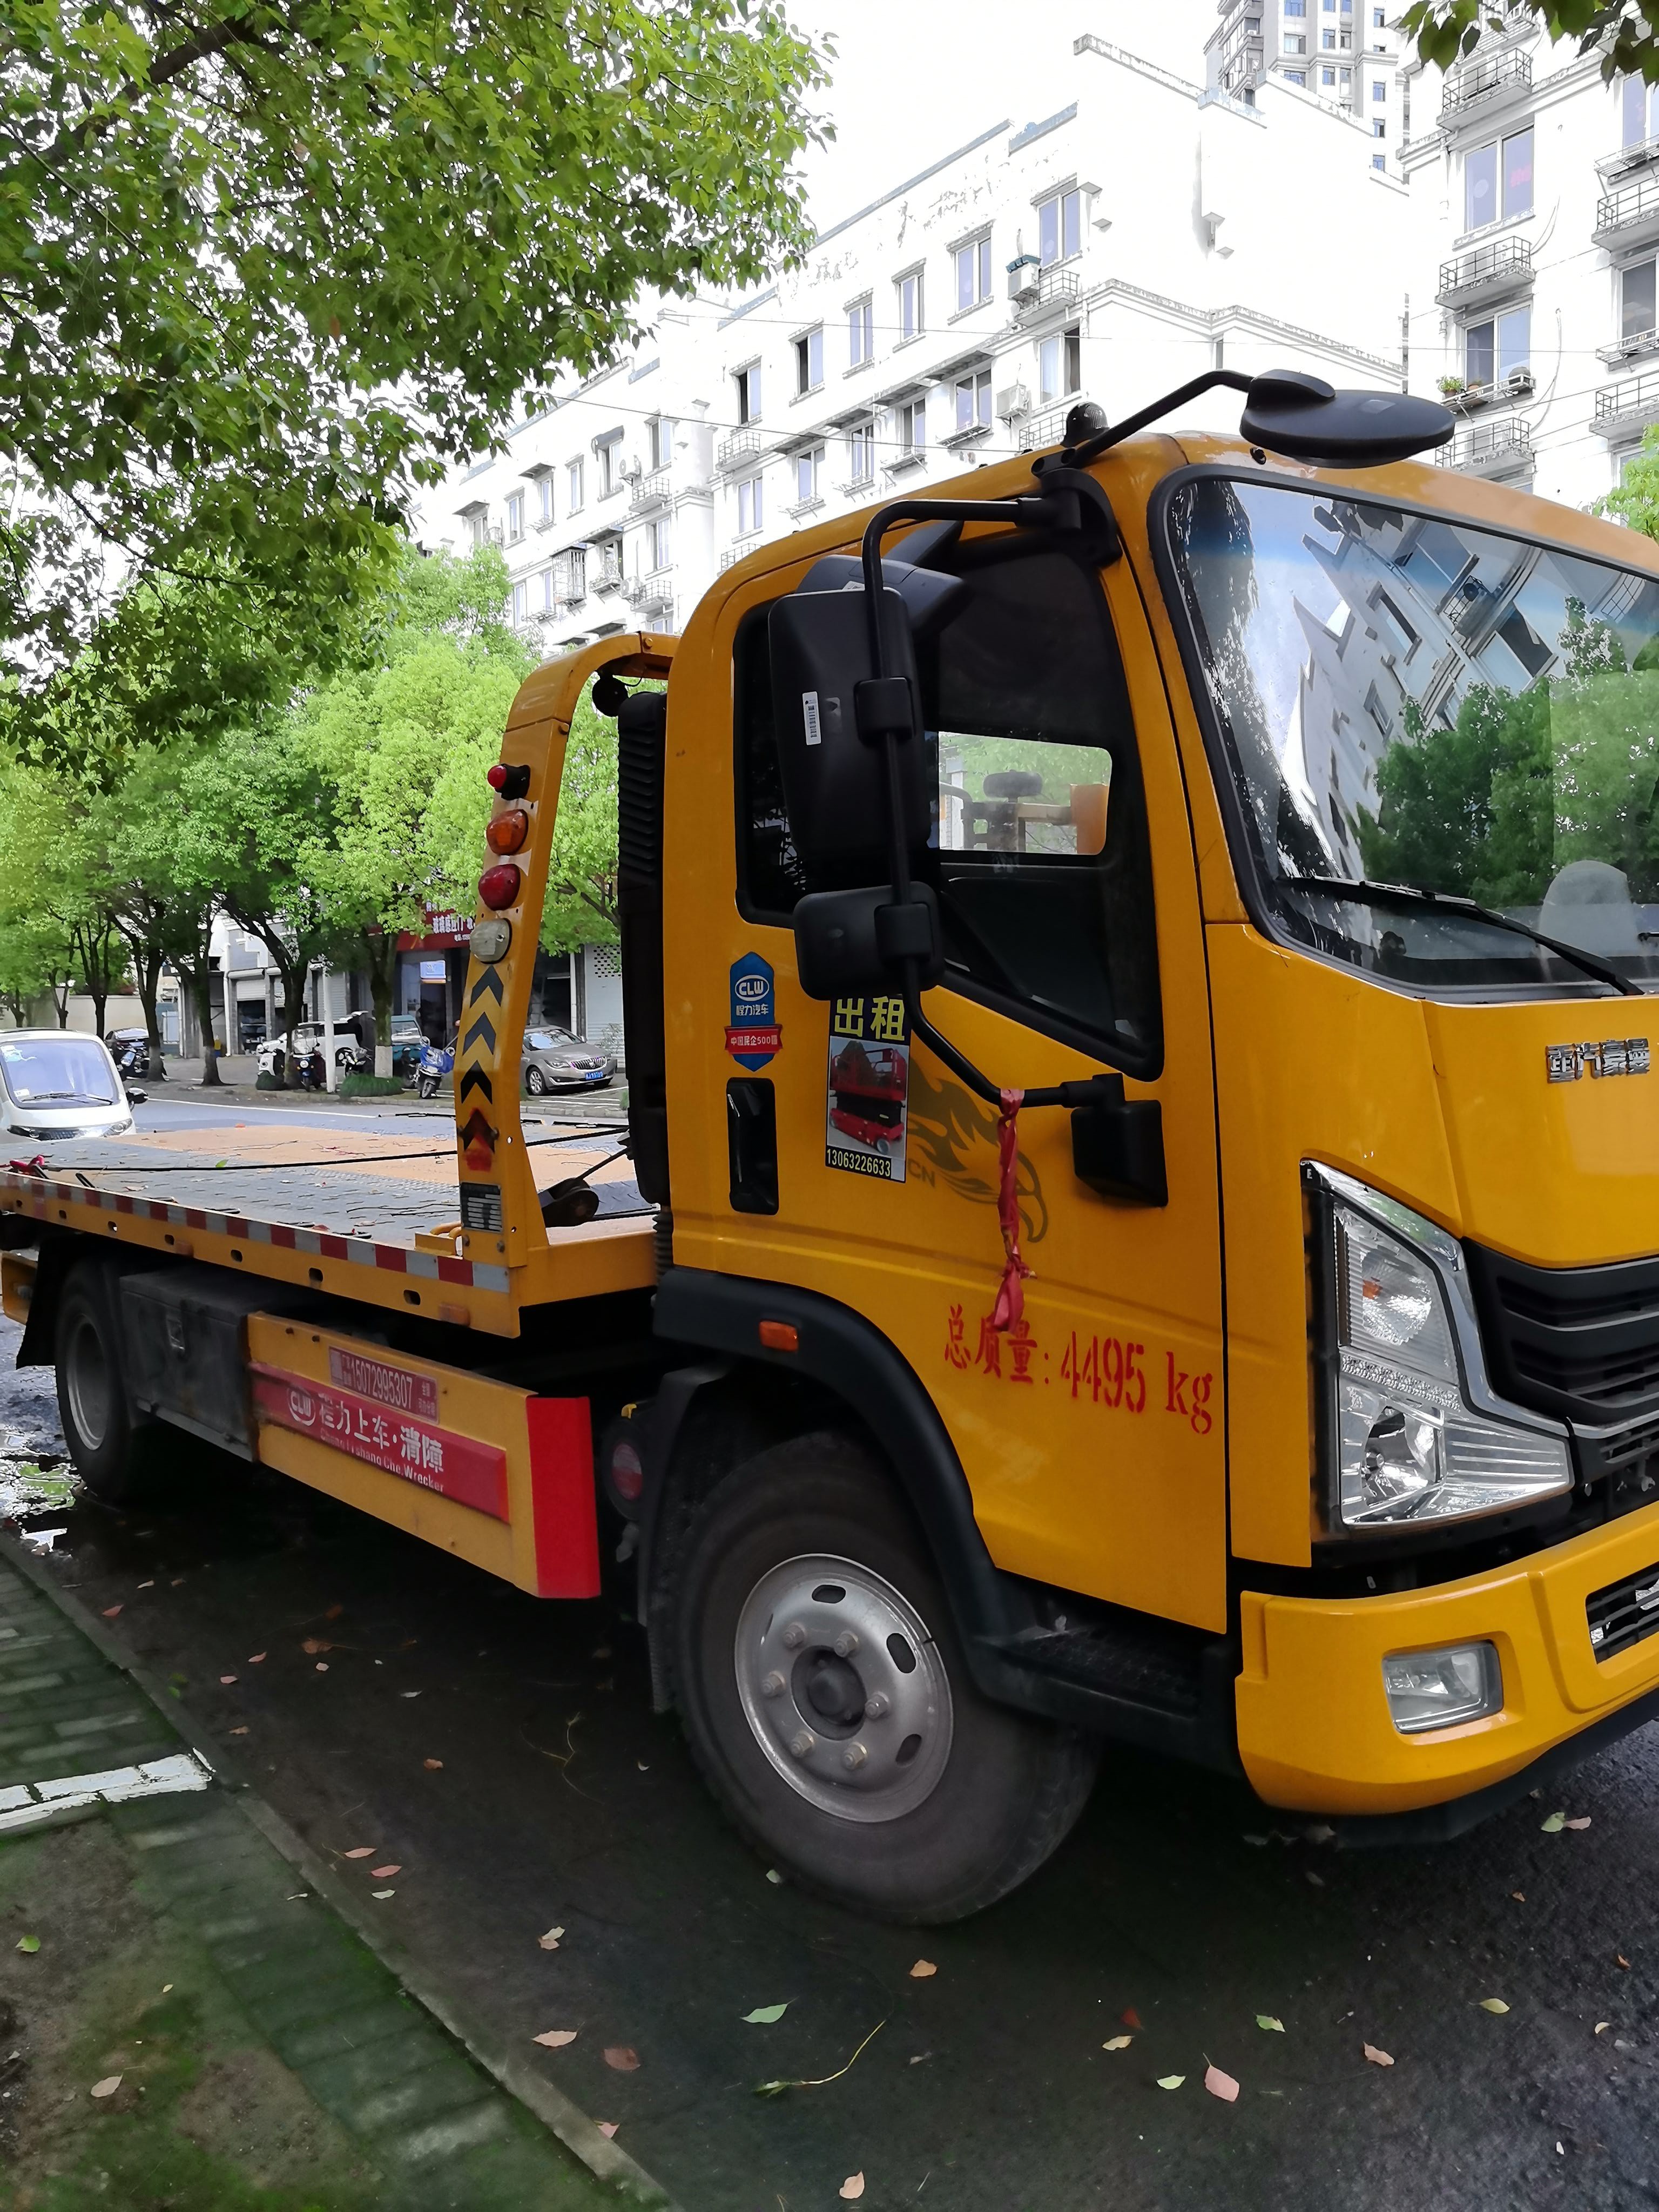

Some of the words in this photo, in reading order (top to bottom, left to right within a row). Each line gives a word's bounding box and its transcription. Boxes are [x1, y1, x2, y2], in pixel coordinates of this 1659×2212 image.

[739, 980, 764, 996] CLW
[834, 995, 905, 1041] 出租
[827, 1148, 891, 1177] 13063226633
[352, 1357, 413, 1410] 15072995307
[290, 1391, 312, 1418] CLW
